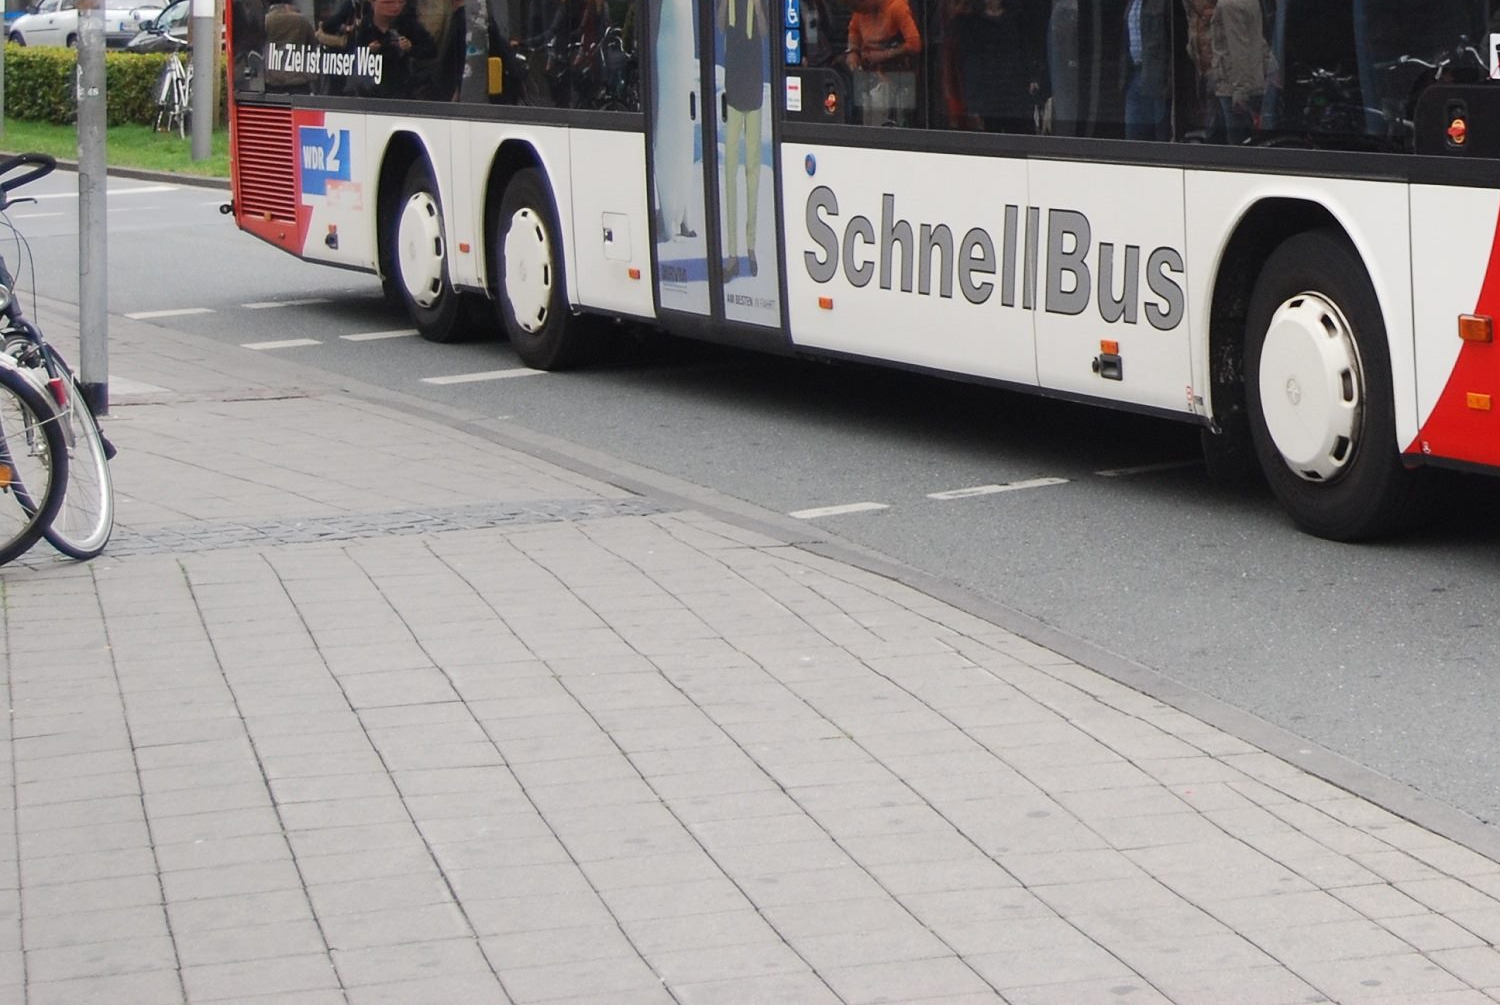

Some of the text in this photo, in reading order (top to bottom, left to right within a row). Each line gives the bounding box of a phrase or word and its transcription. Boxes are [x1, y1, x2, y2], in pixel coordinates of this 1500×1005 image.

[268, 42, 384, 85] Ihr Ziel ist unser Weg
[302, 126, 342, 172] WDR 2
[804, 185, 1185, 332] SchnellBus
